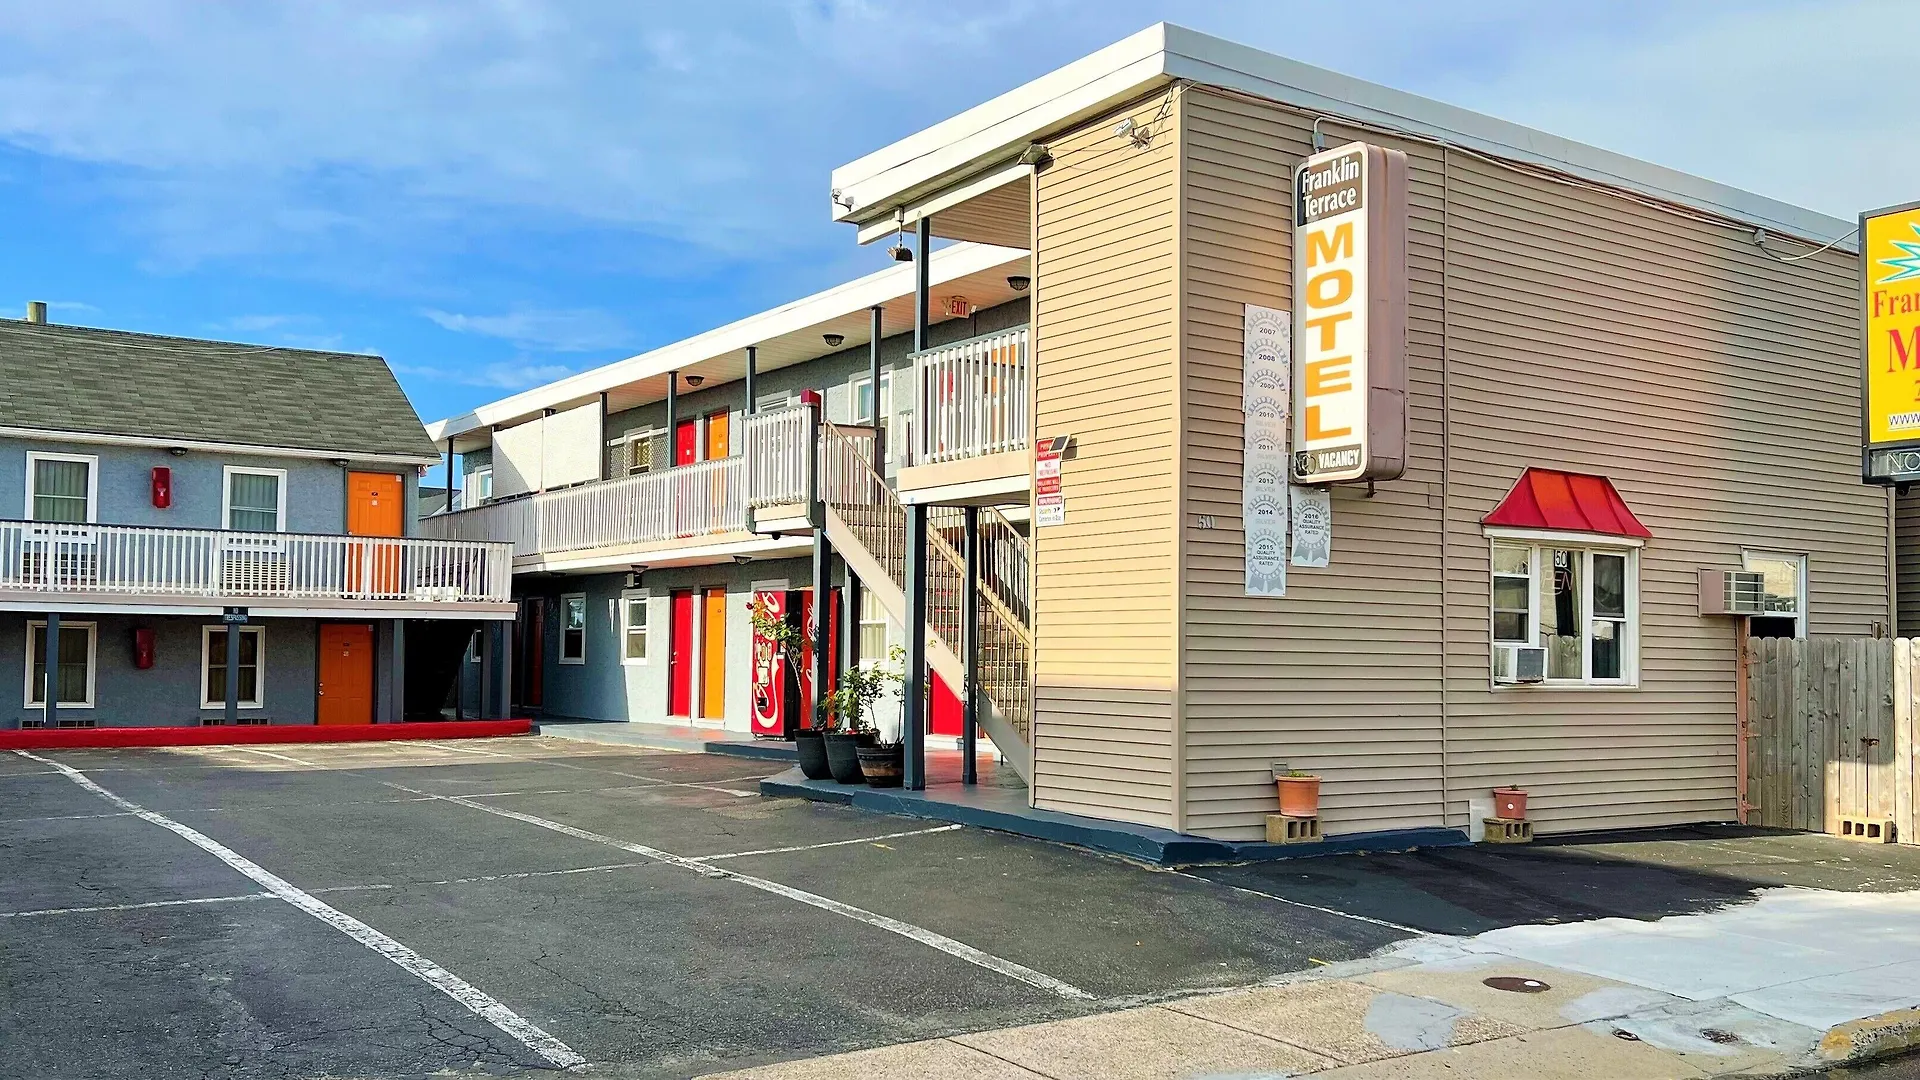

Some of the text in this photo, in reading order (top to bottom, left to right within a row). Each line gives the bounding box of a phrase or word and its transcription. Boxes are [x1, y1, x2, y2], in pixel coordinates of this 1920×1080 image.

[1302, 156, 1359, 194] Franklin
[1303, 187, 1356, 218] Terrace
[951, 299, 967, 316] EXIT
[1259, 327, 1276, 335] 2007
[1305, 222, 1353, 442] MOTEL
[1258, 353, 1276, 362] 2008
[1259, 382, 1275, 390] 2009
[1258, 443, 1273, 451] 2011
[1318, 448, 1360, 469] VACANCY
[1887, 451, 1920, 471] NO
[1258, 477, 1274, 485] 2013
